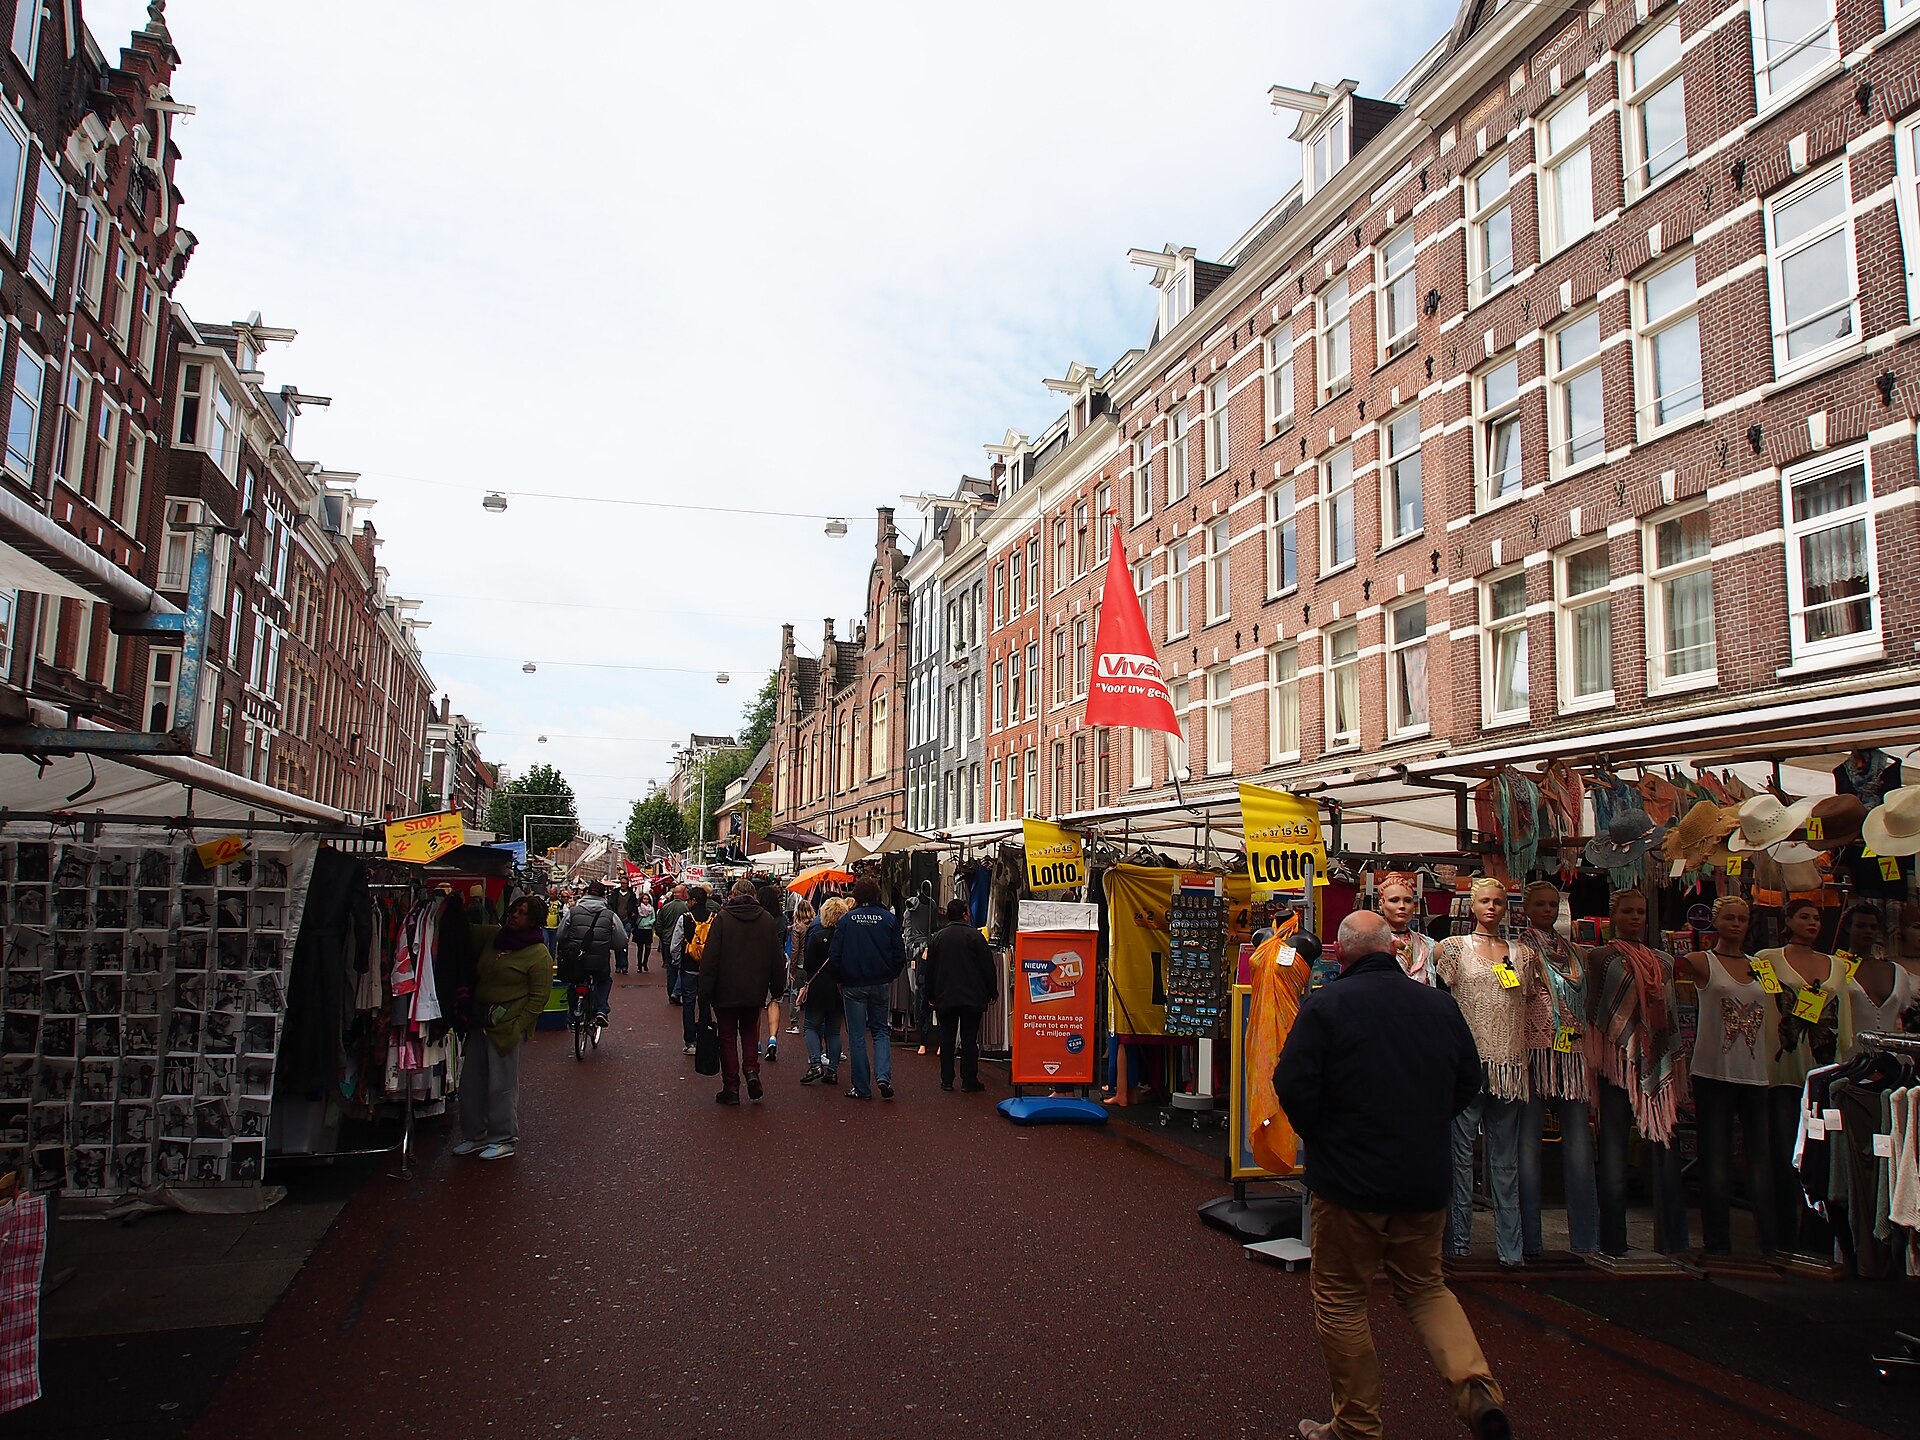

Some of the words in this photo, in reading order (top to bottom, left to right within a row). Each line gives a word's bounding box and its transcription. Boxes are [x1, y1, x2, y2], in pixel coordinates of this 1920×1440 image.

[1128, 685, 1146, 695] uw
[404, 814, 443, 832] STOP!
[1270, 829, 1279, 837] 37
[1281, 827, 1292, 836] 15
[1294, 825, 1309, 835] 45
[1062, 844, 1073, 852] 45
[1031, 861, 1083, 887] Lotto.
[1147, 910, 1154, 921] 2
[1024, 962, 1048, 970] NIEUW
[1058, 963, 1080, 979] XL
[1046, 1030, 1071, 1038] miljoen
